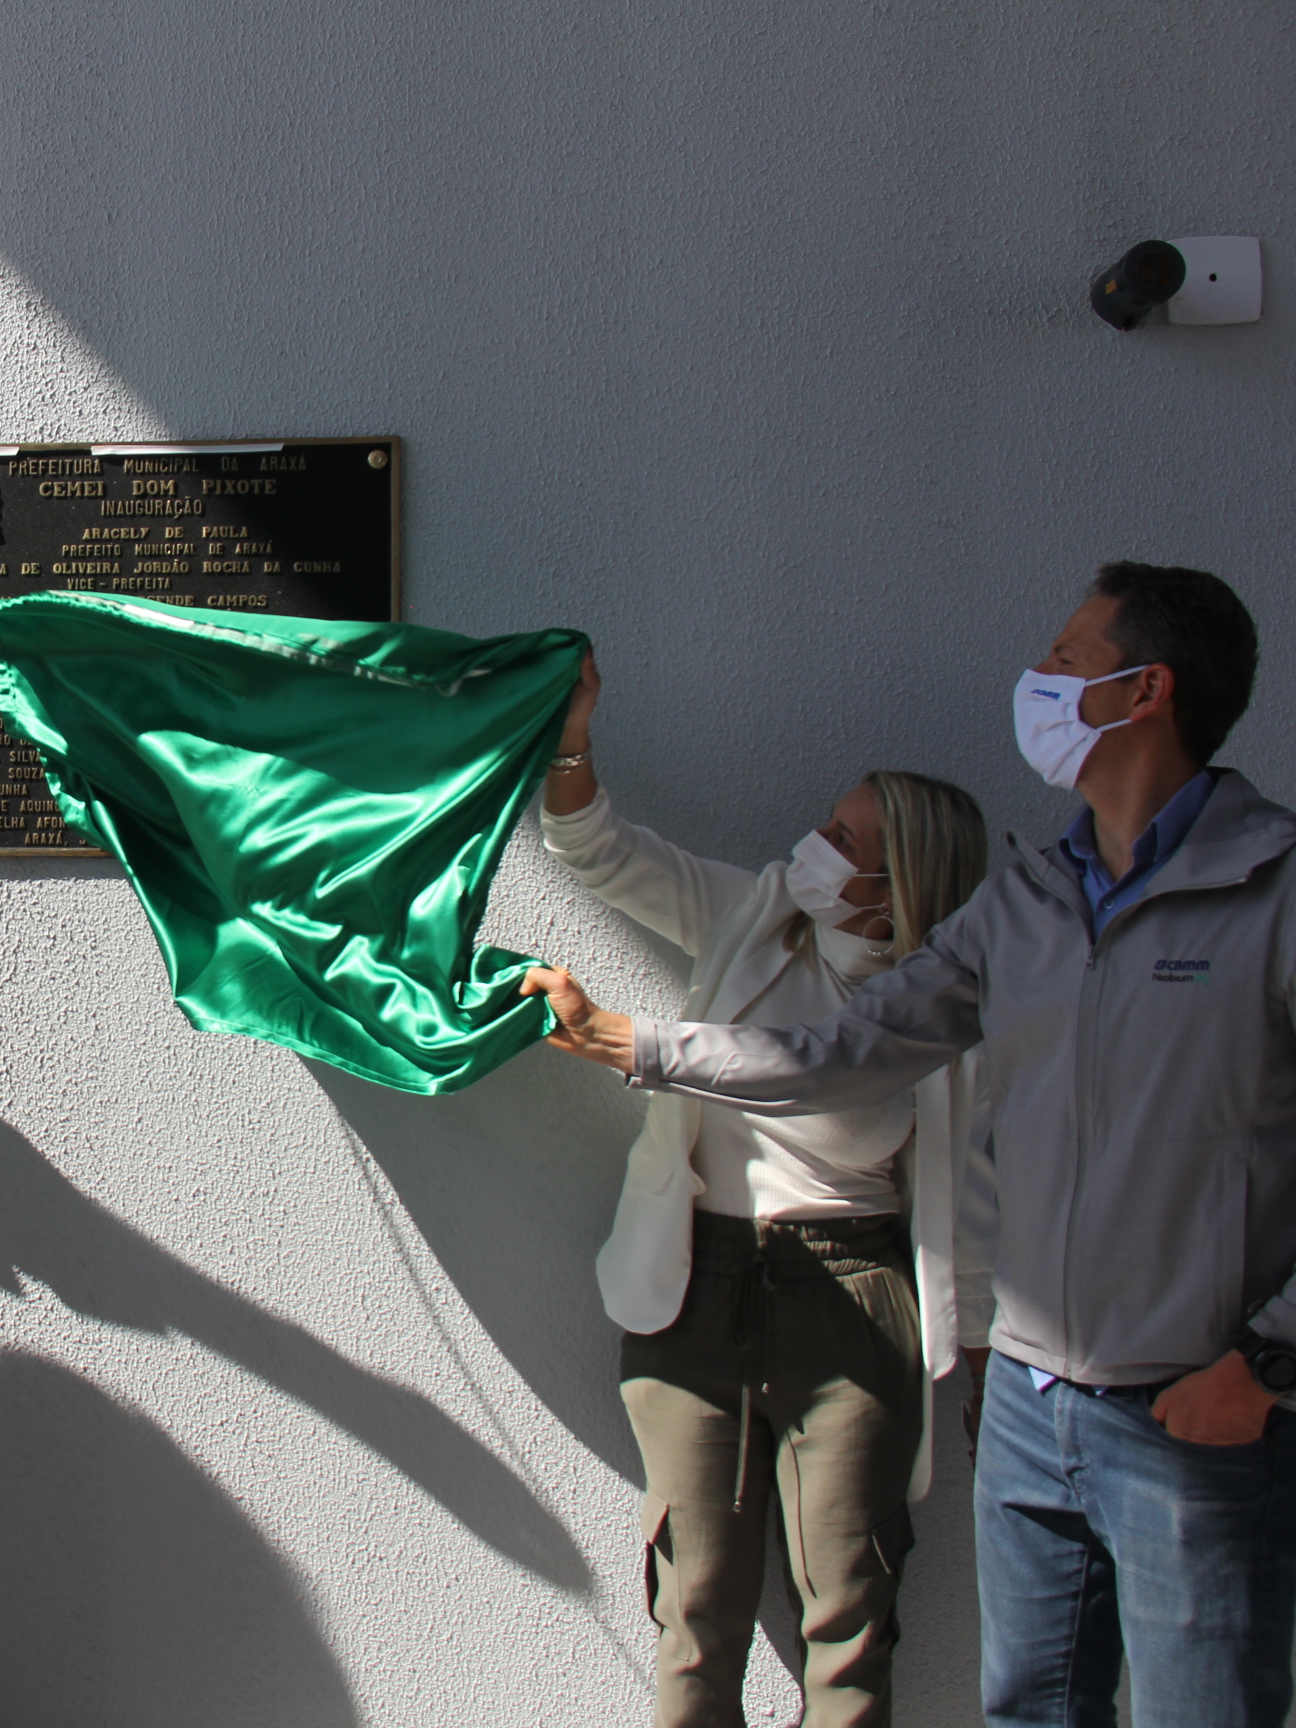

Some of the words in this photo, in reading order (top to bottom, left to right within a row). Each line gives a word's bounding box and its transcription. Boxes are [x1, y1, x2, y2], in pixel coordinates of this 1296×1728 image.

[9, 459, 101, 475] PREFEITURA
[124, 458, 200, 473] MUNICIPAL
[222, 457, 238, 471] DA
[260, 452, 306, 470] ARAXÁ
[39, 481, 104, 496] CEMEI
[133, 480, 175, 495] DOM
[203, 479, 277, 494] PIXOTE
[101, 496, 202, 518] INAUGURAÇÃO
[83, 527, 150, 539] ARACELY
[166, 527, 184, 538] DE
[202, 526, 248, 538] PAULA
[62, 545, 120, 556] PREFEITO
[135, 544, 196, 555] MUNICIPAL
[209, 543, 223, 555] DE
[235, 540, 272, 554] ARAXÁ
[21, 563, 39, 574] DE
[54, 562, 120, 574] OLIVEIRA
[134, 559, 189, 573] JORDÃO
[203, 561, 250, 573] ROCHA
[264, 562, 281, 572] DA
[294, 562, 341, 572] CUNHA
[207, 595, 267, 606] CAMPOS
[9, 751, 41, 762] SILVA
[8, 767, 45, 779] SOUZA
[36, 817, 68, 829] AFON
[25, 832, 68, 846] ARAXÁ,
